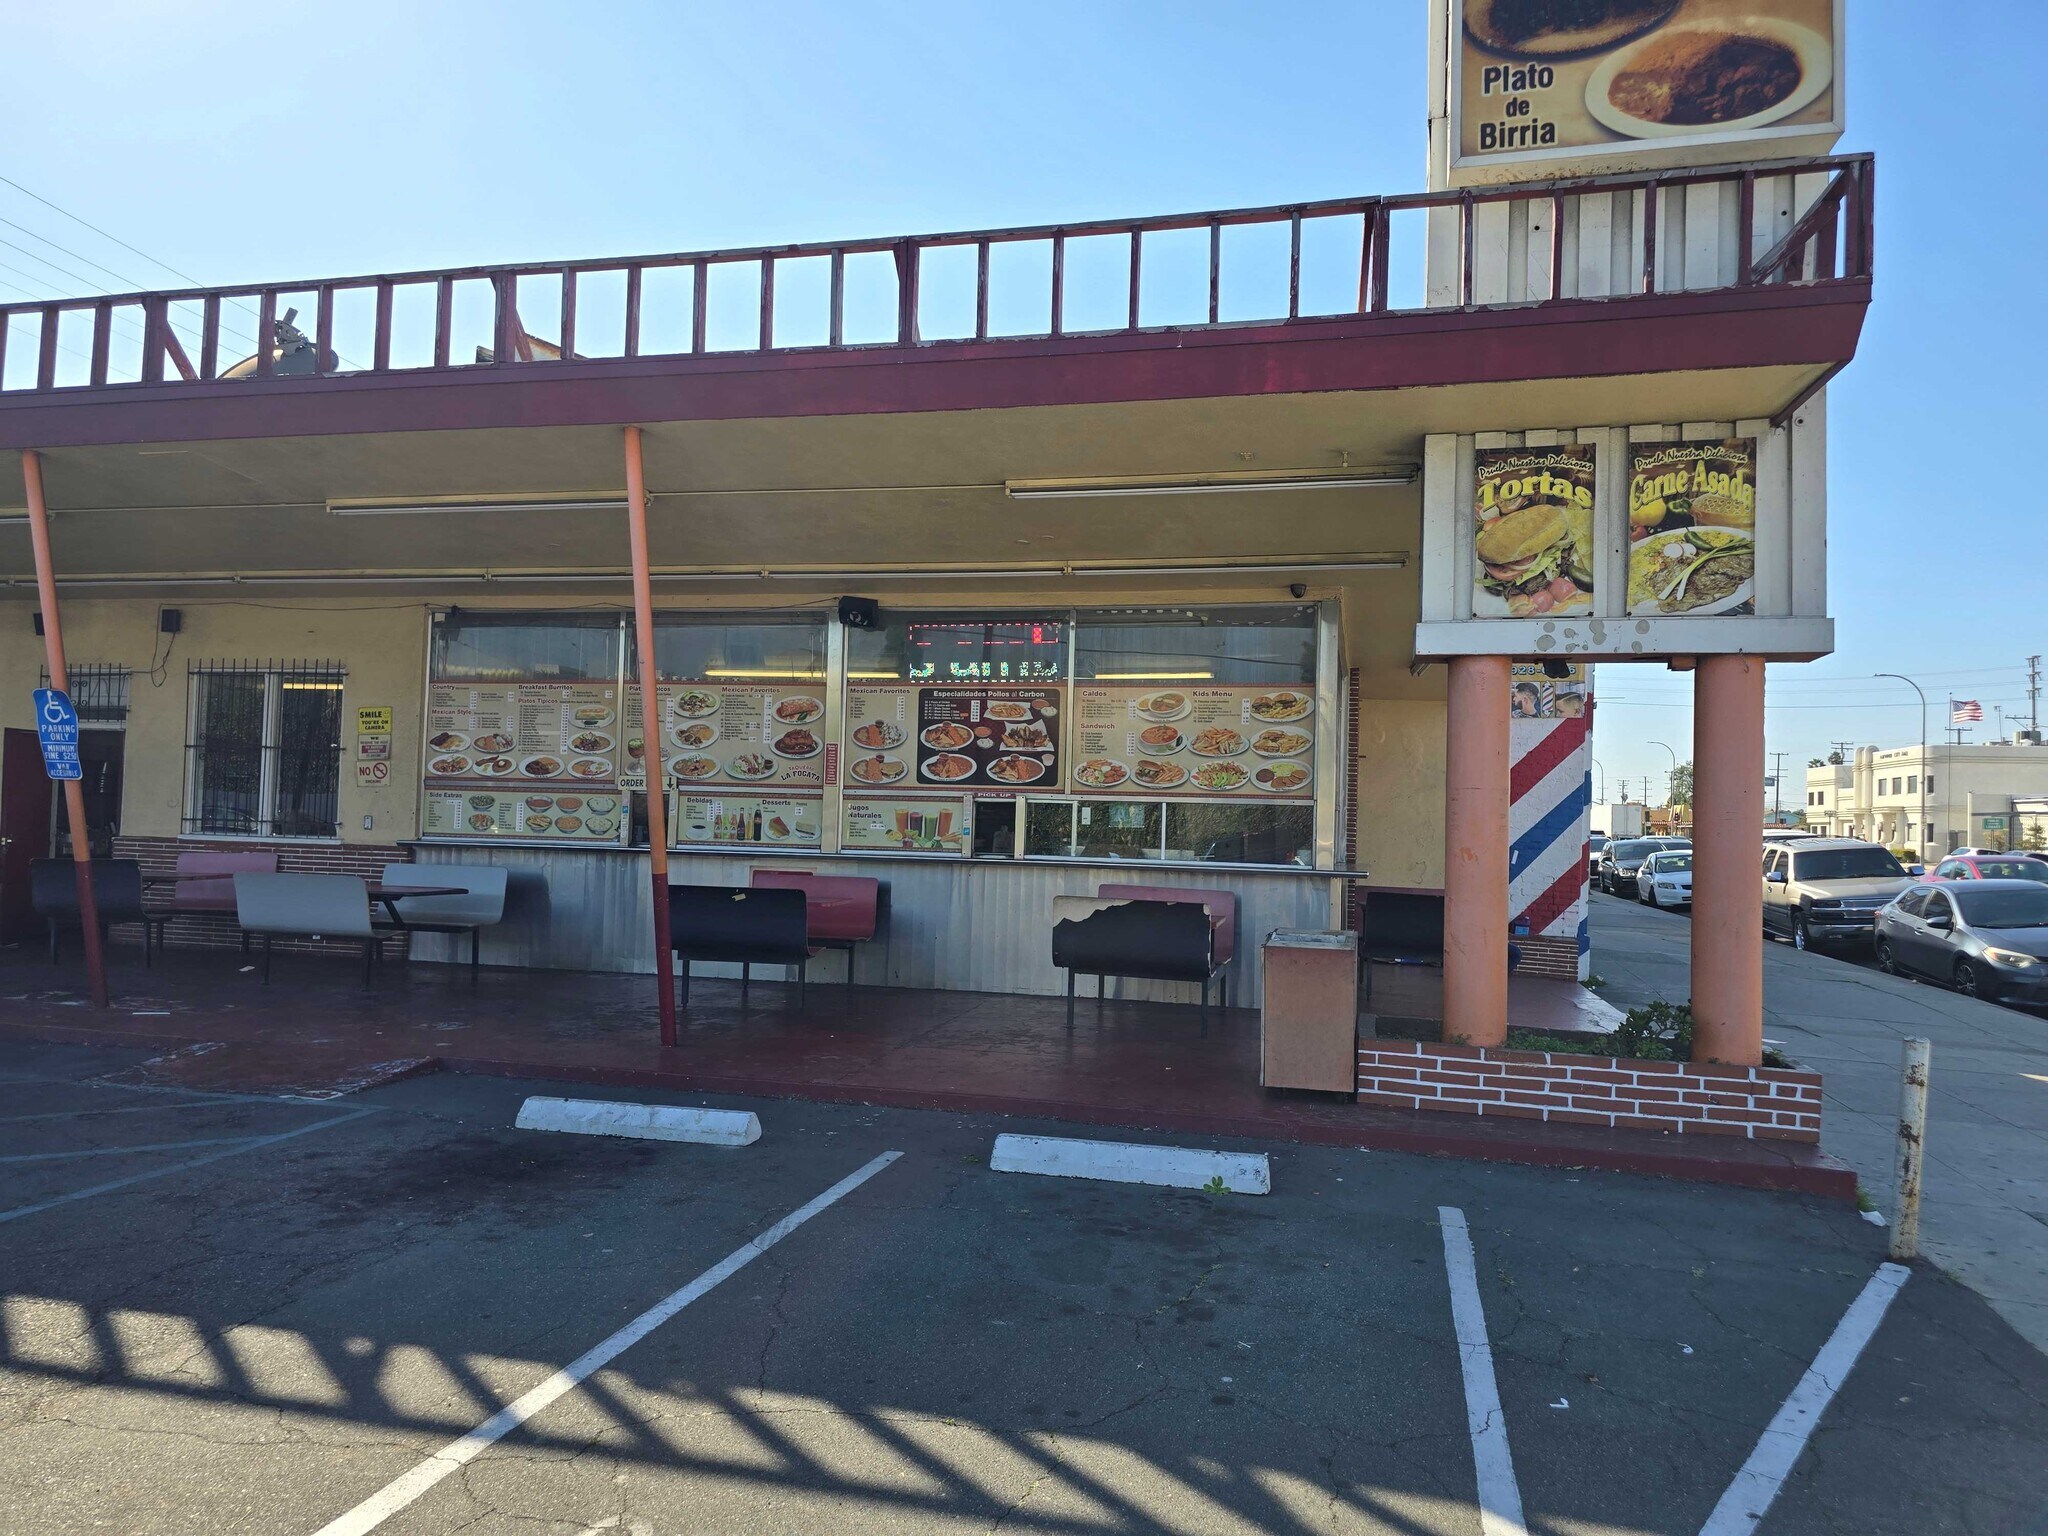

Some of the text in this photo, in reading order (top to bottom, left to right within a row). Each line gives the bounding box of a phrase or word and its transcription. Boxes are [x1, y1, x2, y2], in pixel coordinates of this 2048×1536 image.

[1484, 63, 1554, 94] Plato
[1505, 96, 1530, 118] de
[1480, 118, 1555, 150] Birria
[1635, 446, 1748, 470] Pruebe Nuestra Deliciosa
[1479, 454, 1593, 478] Pruebe Nuestras Deliciosas
[1630, 459, 1753, 511] Carne Asada
[1477, 471, 1593, 511] Tortas
[1511, 665, 1576, 675] 928-6
[933, 690, 986, 698] Especialidades
[359, 711, 382, 719] SMILE
[41, 724, 76, 733] PARKING
[50, 732, 70, 741] ONLY
[47, 744, 75, 753] MINIMUM
[44, 751, 60, 760] FINE
[359, 766, 371, 776] NO
[780, 772, 791, 781] LA
[620, 779, 644, 787] ORDER
[848, 803, 869, 812] Jugos
[847, 811, 882, 819] Naturales
